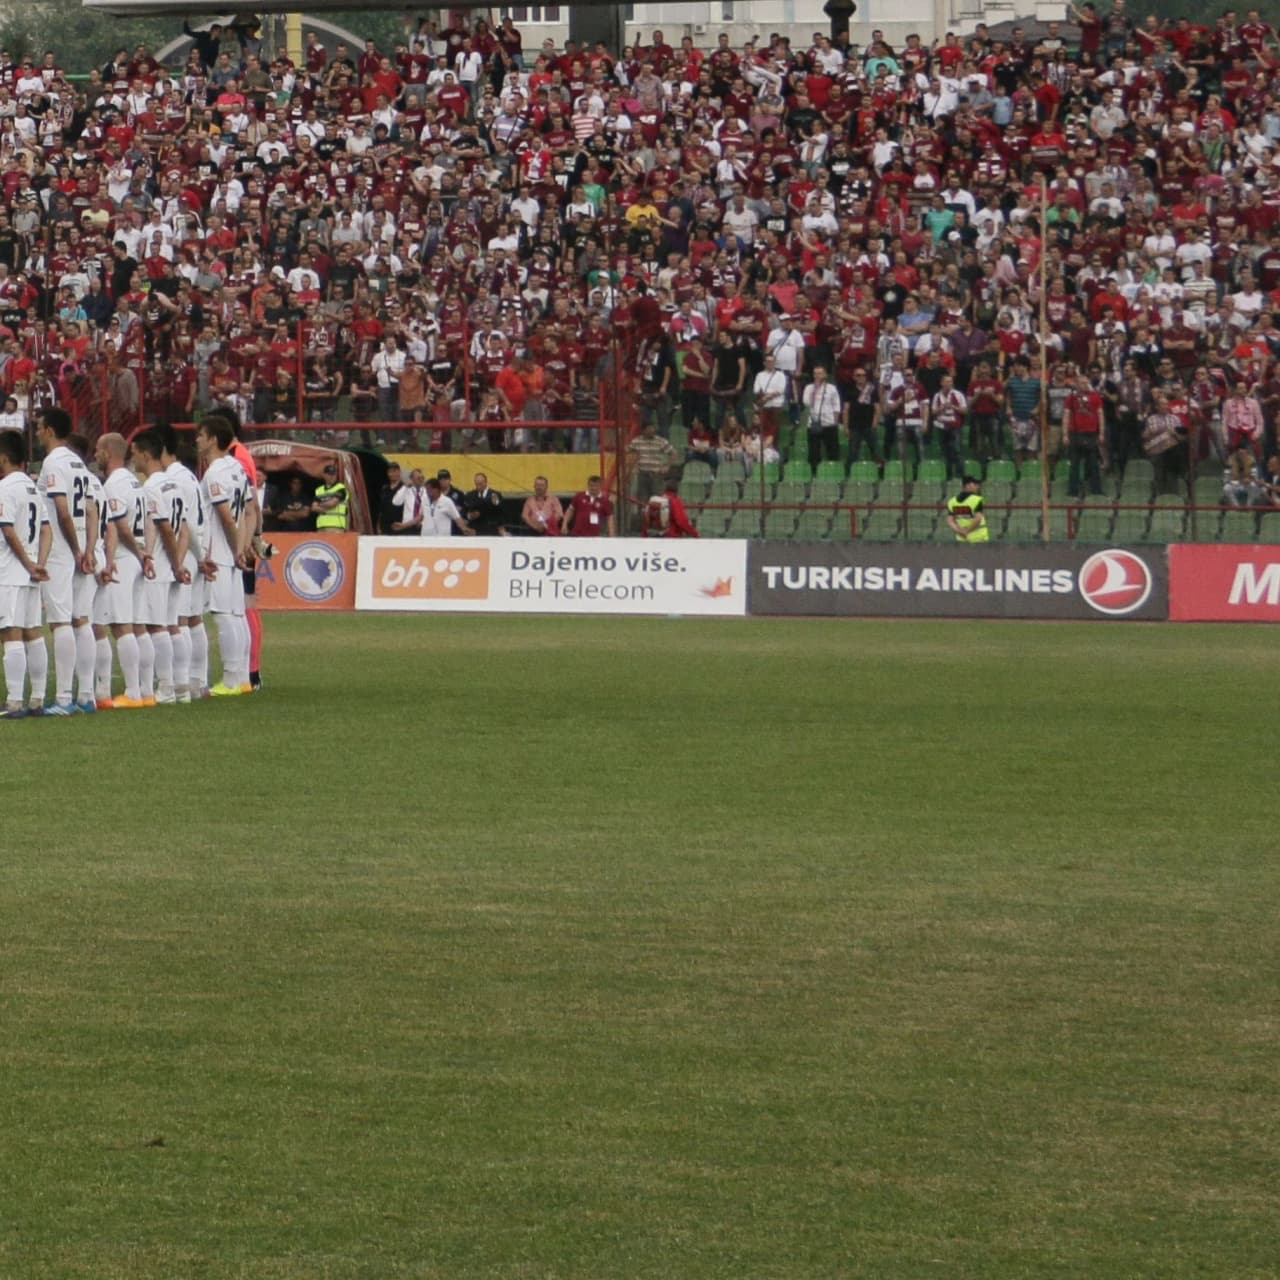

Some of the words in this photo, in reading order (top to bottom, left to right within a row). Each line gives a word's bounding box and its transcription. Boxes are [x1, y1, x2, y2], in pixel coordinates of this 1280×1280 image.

[382, 558, 429, 589] bh
[511, 551, 617, 578] Dajemo
[627, 549, 687, 572] više.
[509, 580, 542, 599] BH
[549, 578, 654, 601] Telecom
[762, 566, 910, 589] TURKISH
[915, 568, 1073, 593] AIRLINES
